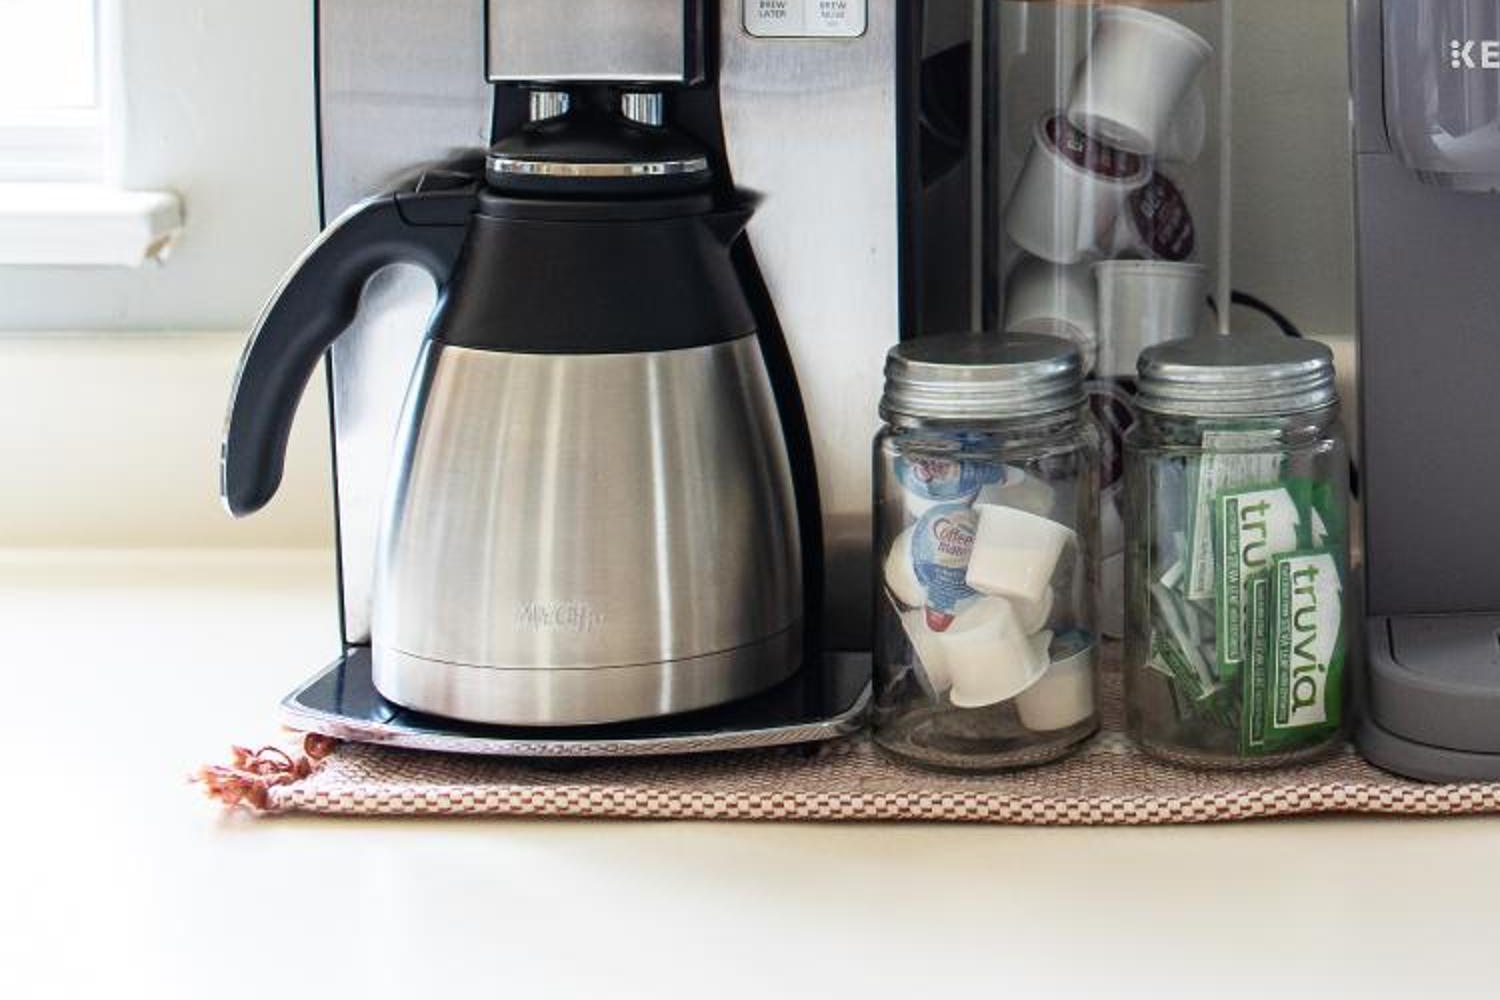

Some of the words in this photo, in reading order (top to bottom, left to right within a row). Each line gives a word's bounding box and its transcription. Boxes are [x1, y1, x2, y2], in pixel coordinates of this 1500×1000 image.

[759, 0, 785, 8] BREW
[759, 10, 786, 19] LATER
[1291, 564, 1325, 713] truvia
